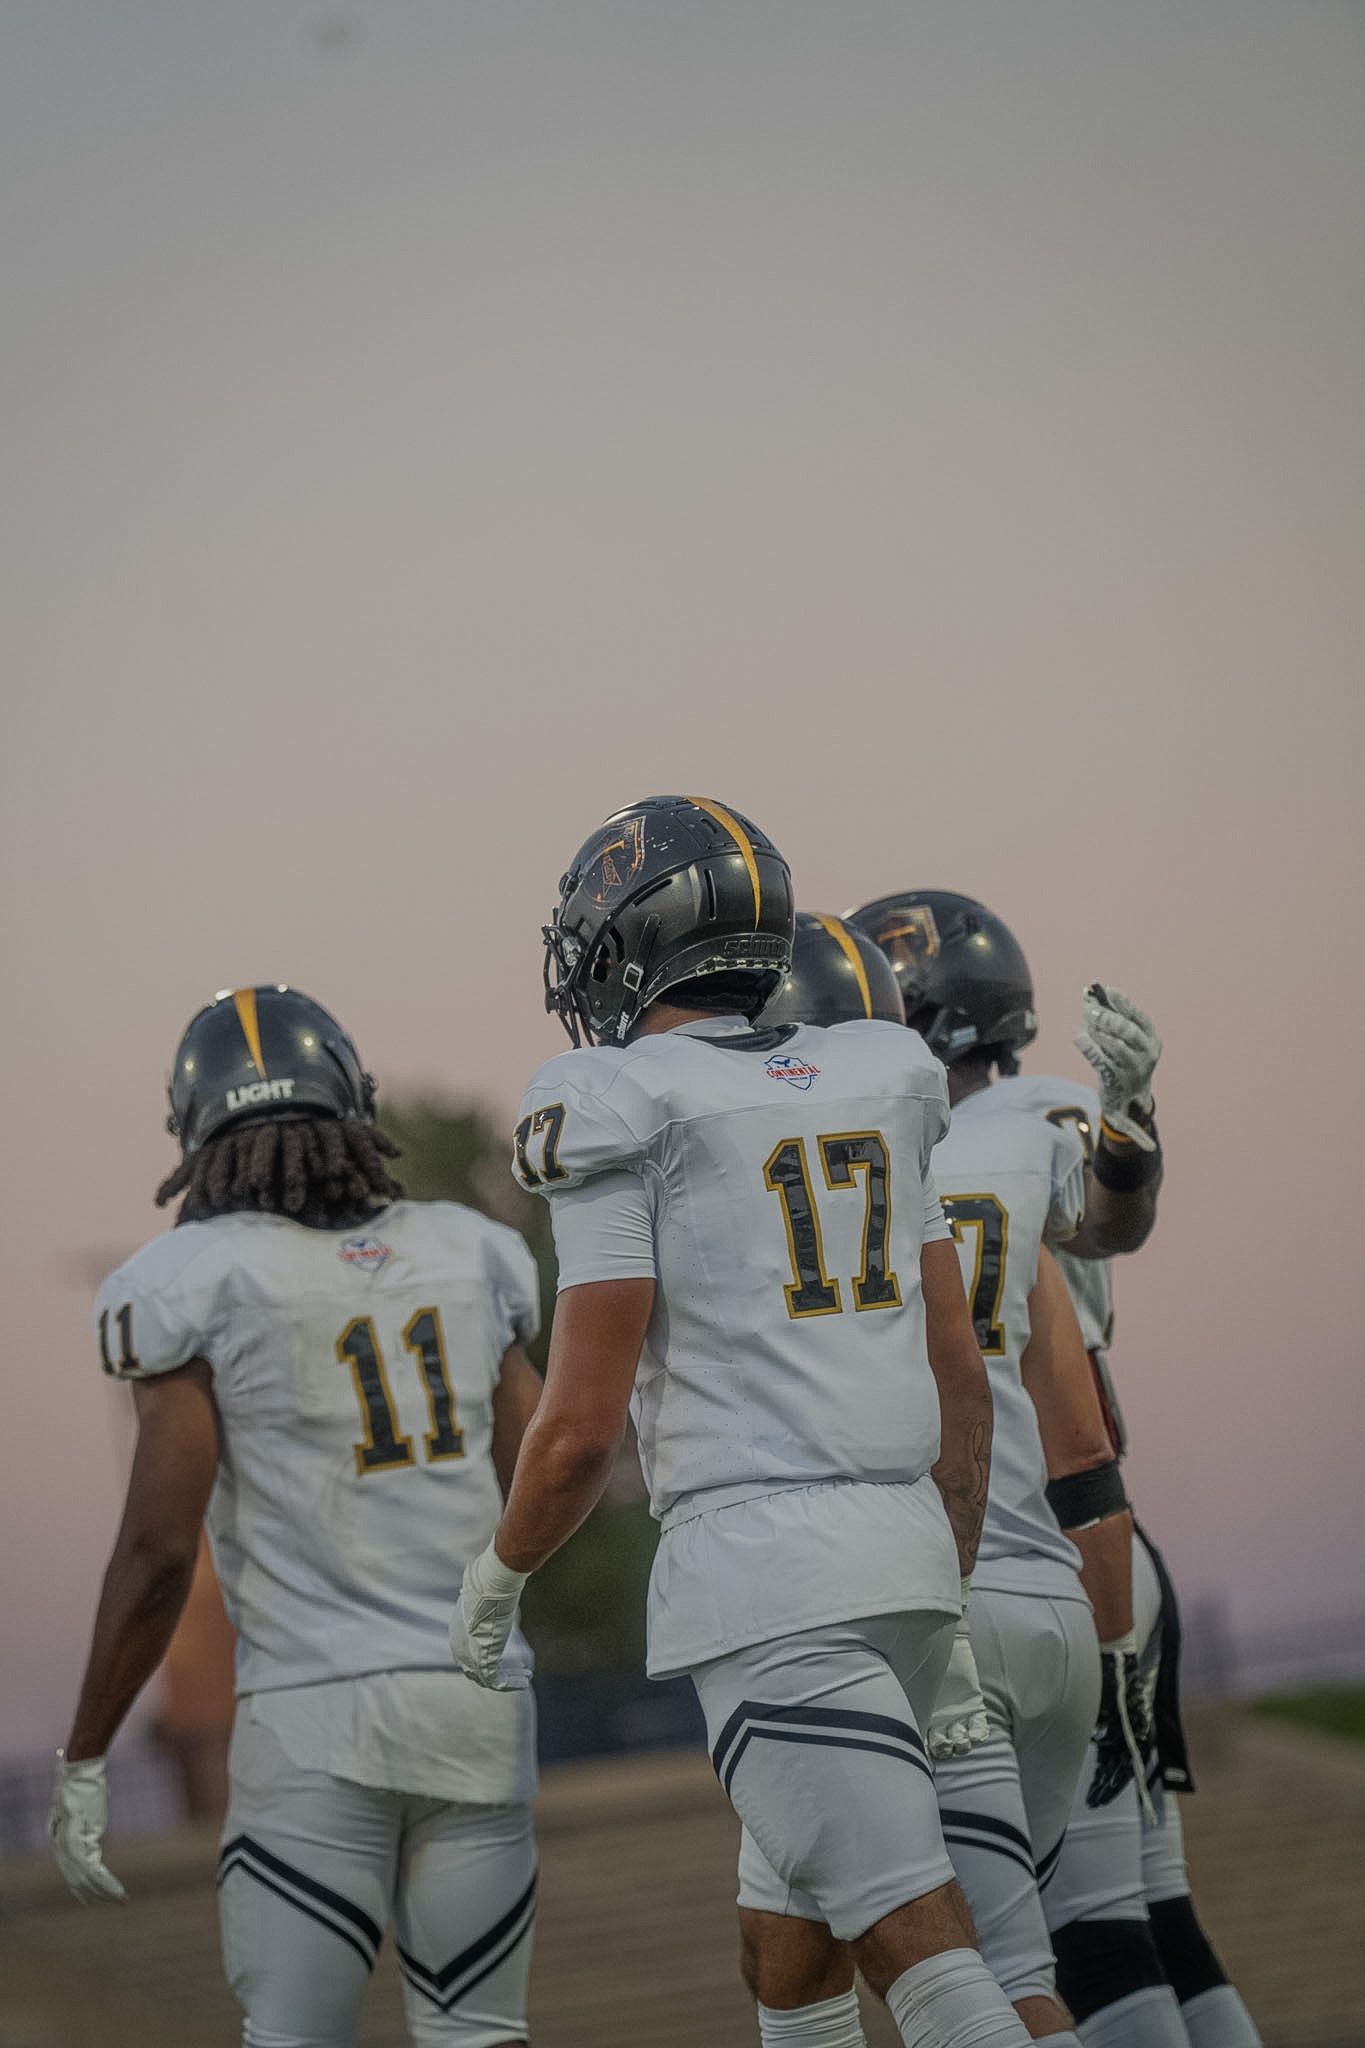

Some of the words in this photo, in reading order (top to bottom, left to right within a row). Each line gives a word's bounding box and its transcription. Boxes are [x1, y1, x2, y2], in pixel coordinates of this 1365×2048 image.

[225, 1079, 296, 1111] LIGHT
[513, 1102, 569, 1188] 17
[763, 1130, 903, 1320] 17
[336, 1306, 466, 1477] 11
